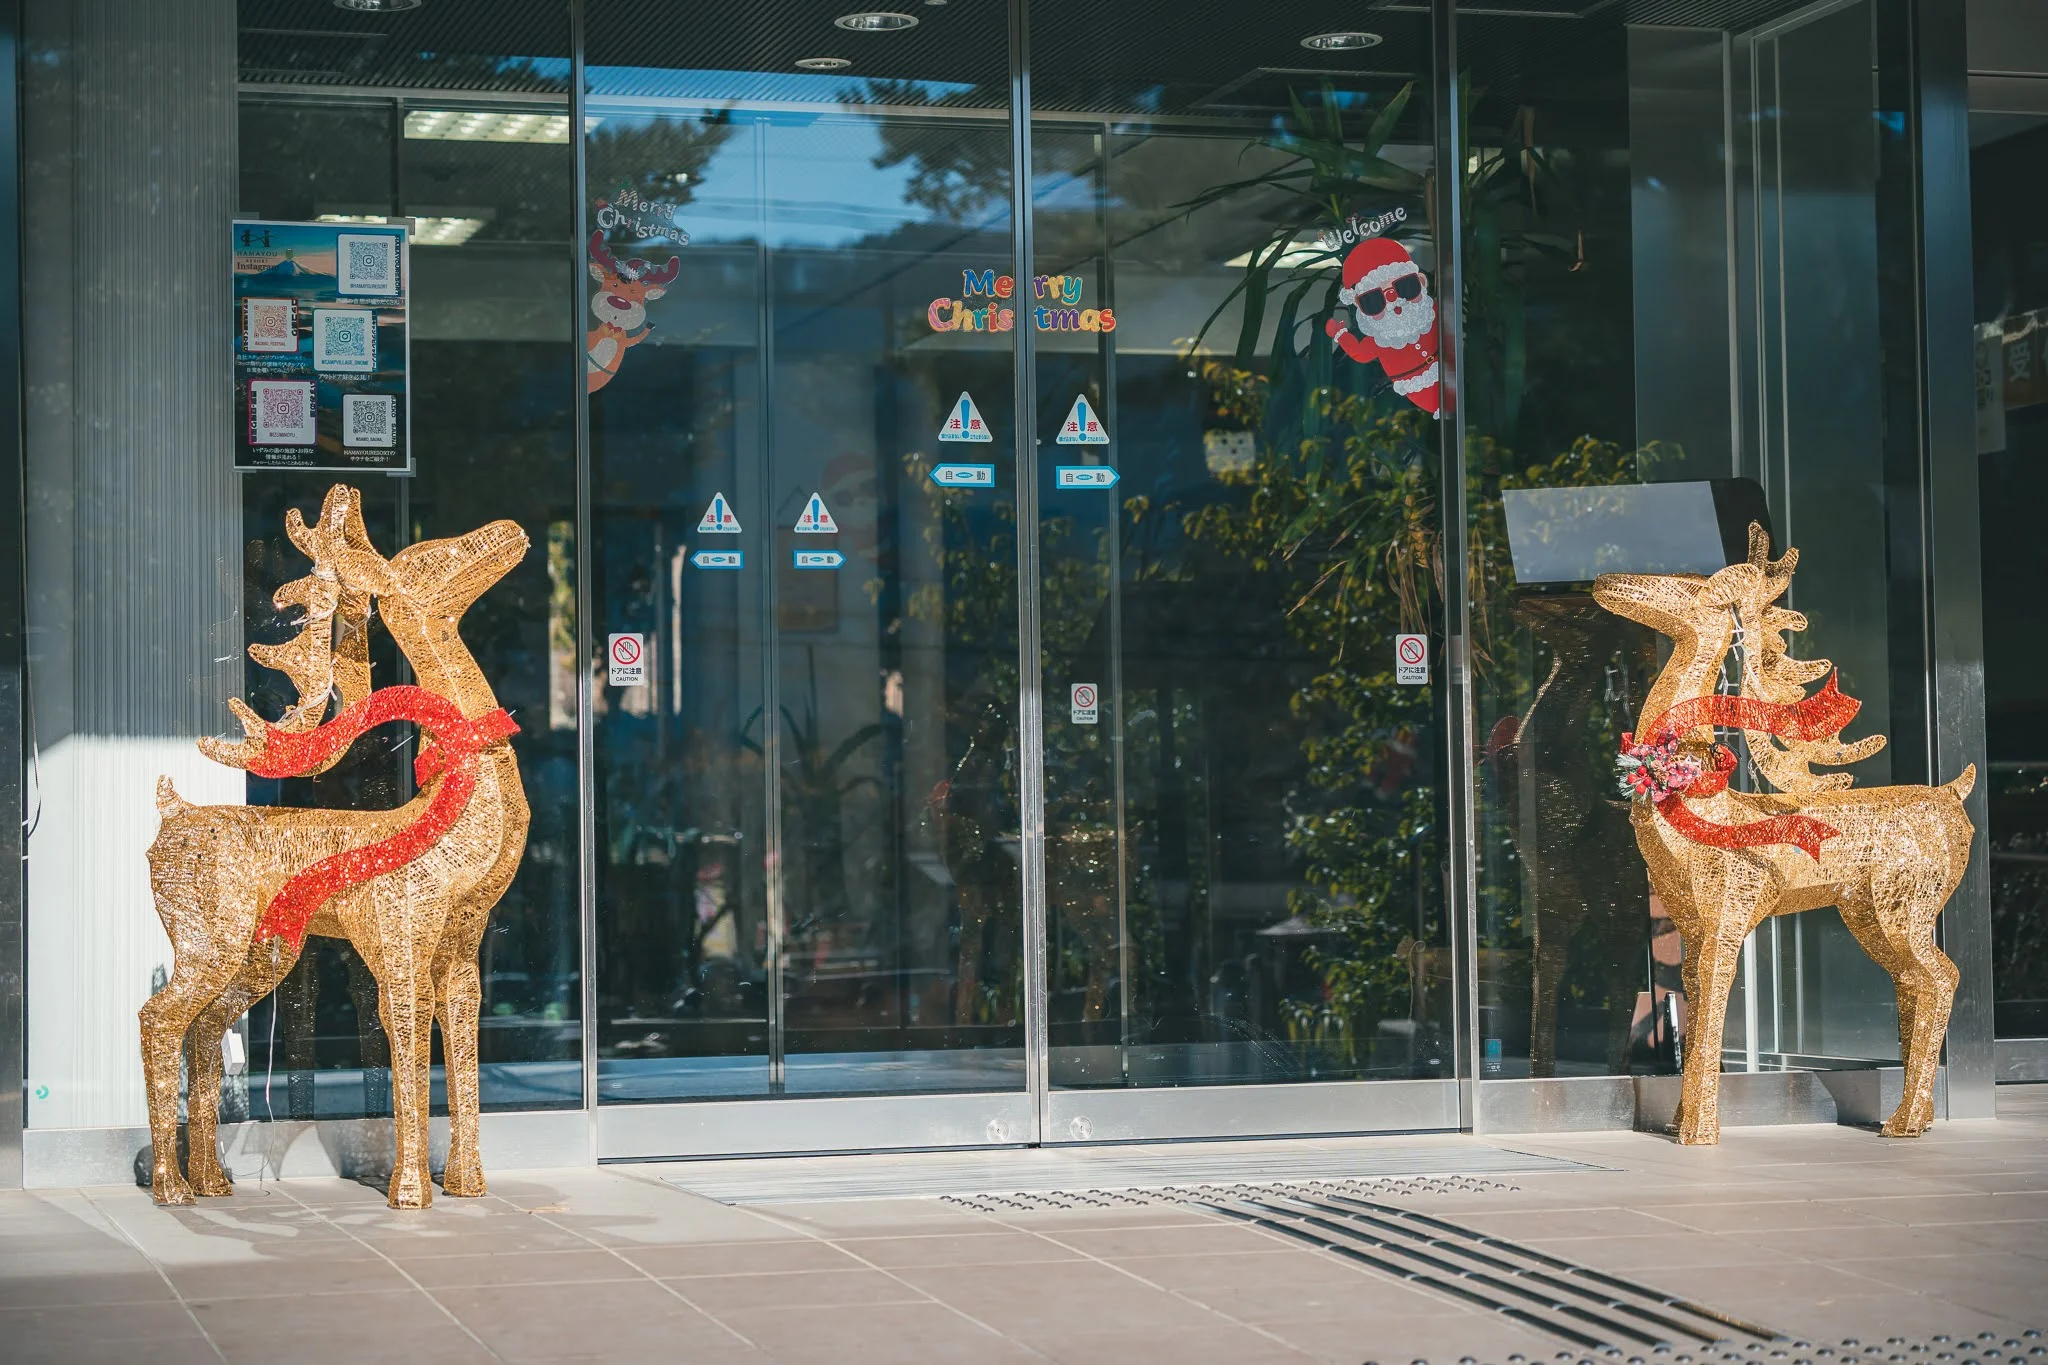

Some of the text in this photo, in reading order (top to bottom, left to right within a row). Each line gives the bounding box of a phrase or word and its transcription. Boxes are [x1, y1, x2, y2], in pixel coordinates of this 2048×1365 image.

[615, 188, 677, 220] Merry
[597, 203, 690, 246] Christmas
[1322, 207, 1407, 250] Welcome
[237, 262, 279, 271] Instagram
